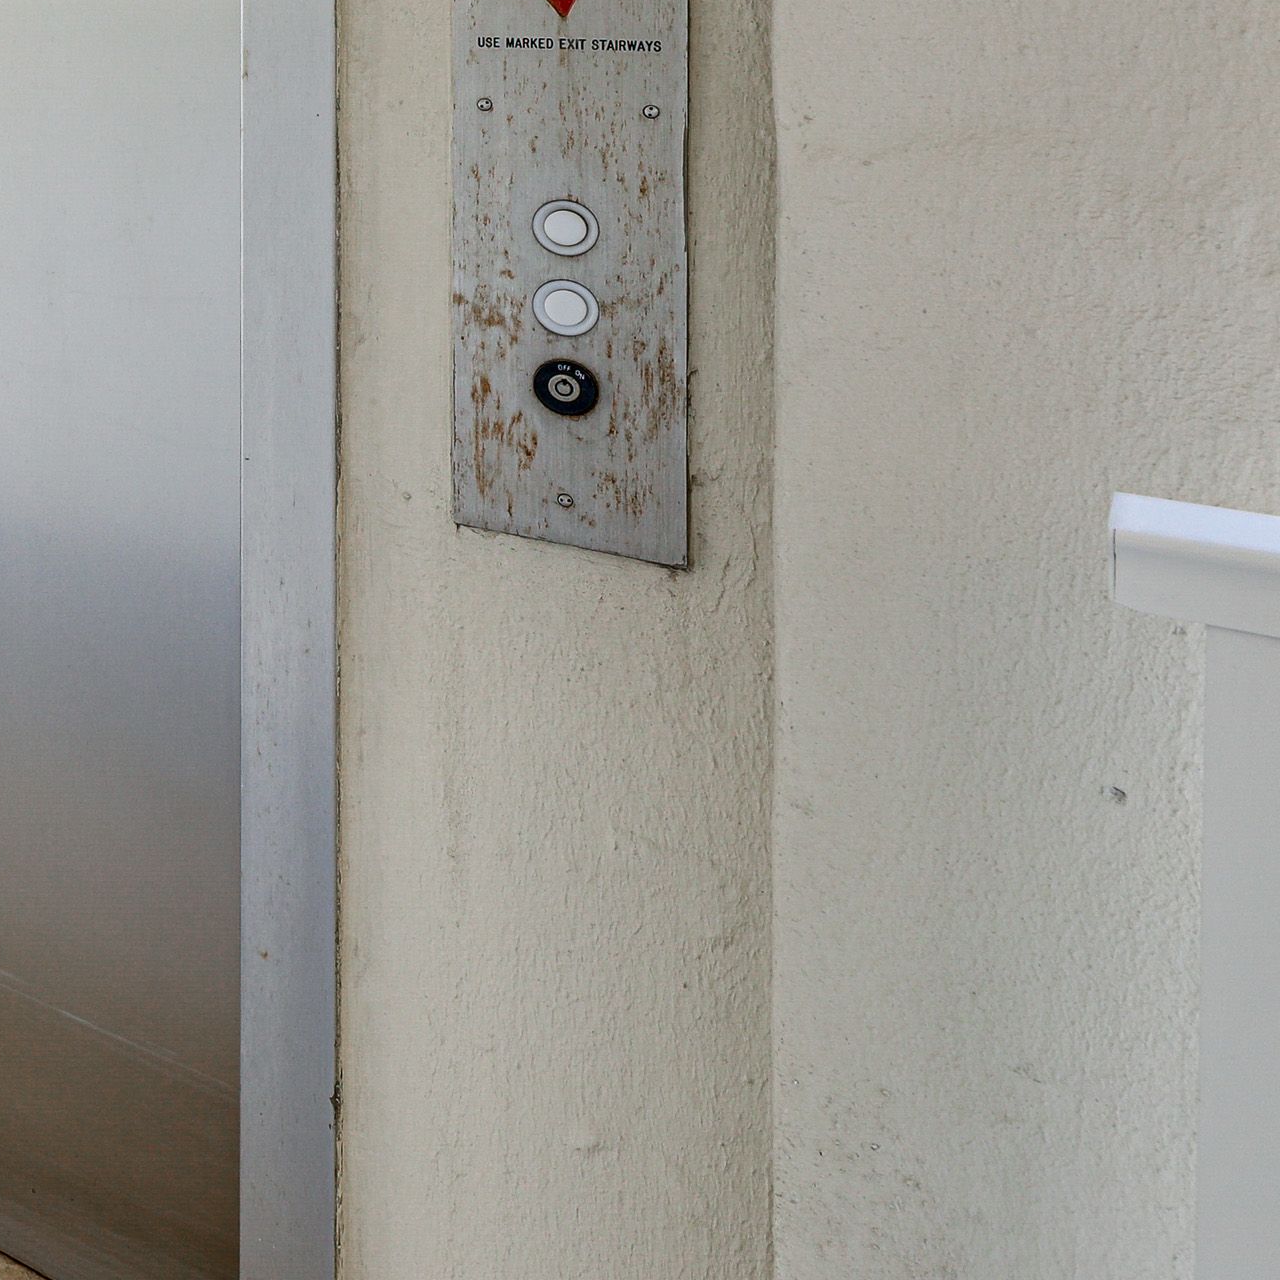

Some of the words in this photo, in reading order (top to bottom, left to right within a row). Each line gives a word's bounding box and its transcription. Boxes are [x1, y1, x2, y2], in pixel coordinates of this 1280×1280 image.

[477, 36, 500, 48] USE
[505, 37, 554, 49] MARKED
[559, 38, 587, 50] EXIT
[591, 39, 662, 53] STAIRWAYS
[557, 364, 571, 372] OFF
[574, 369, 585, 380] ON
